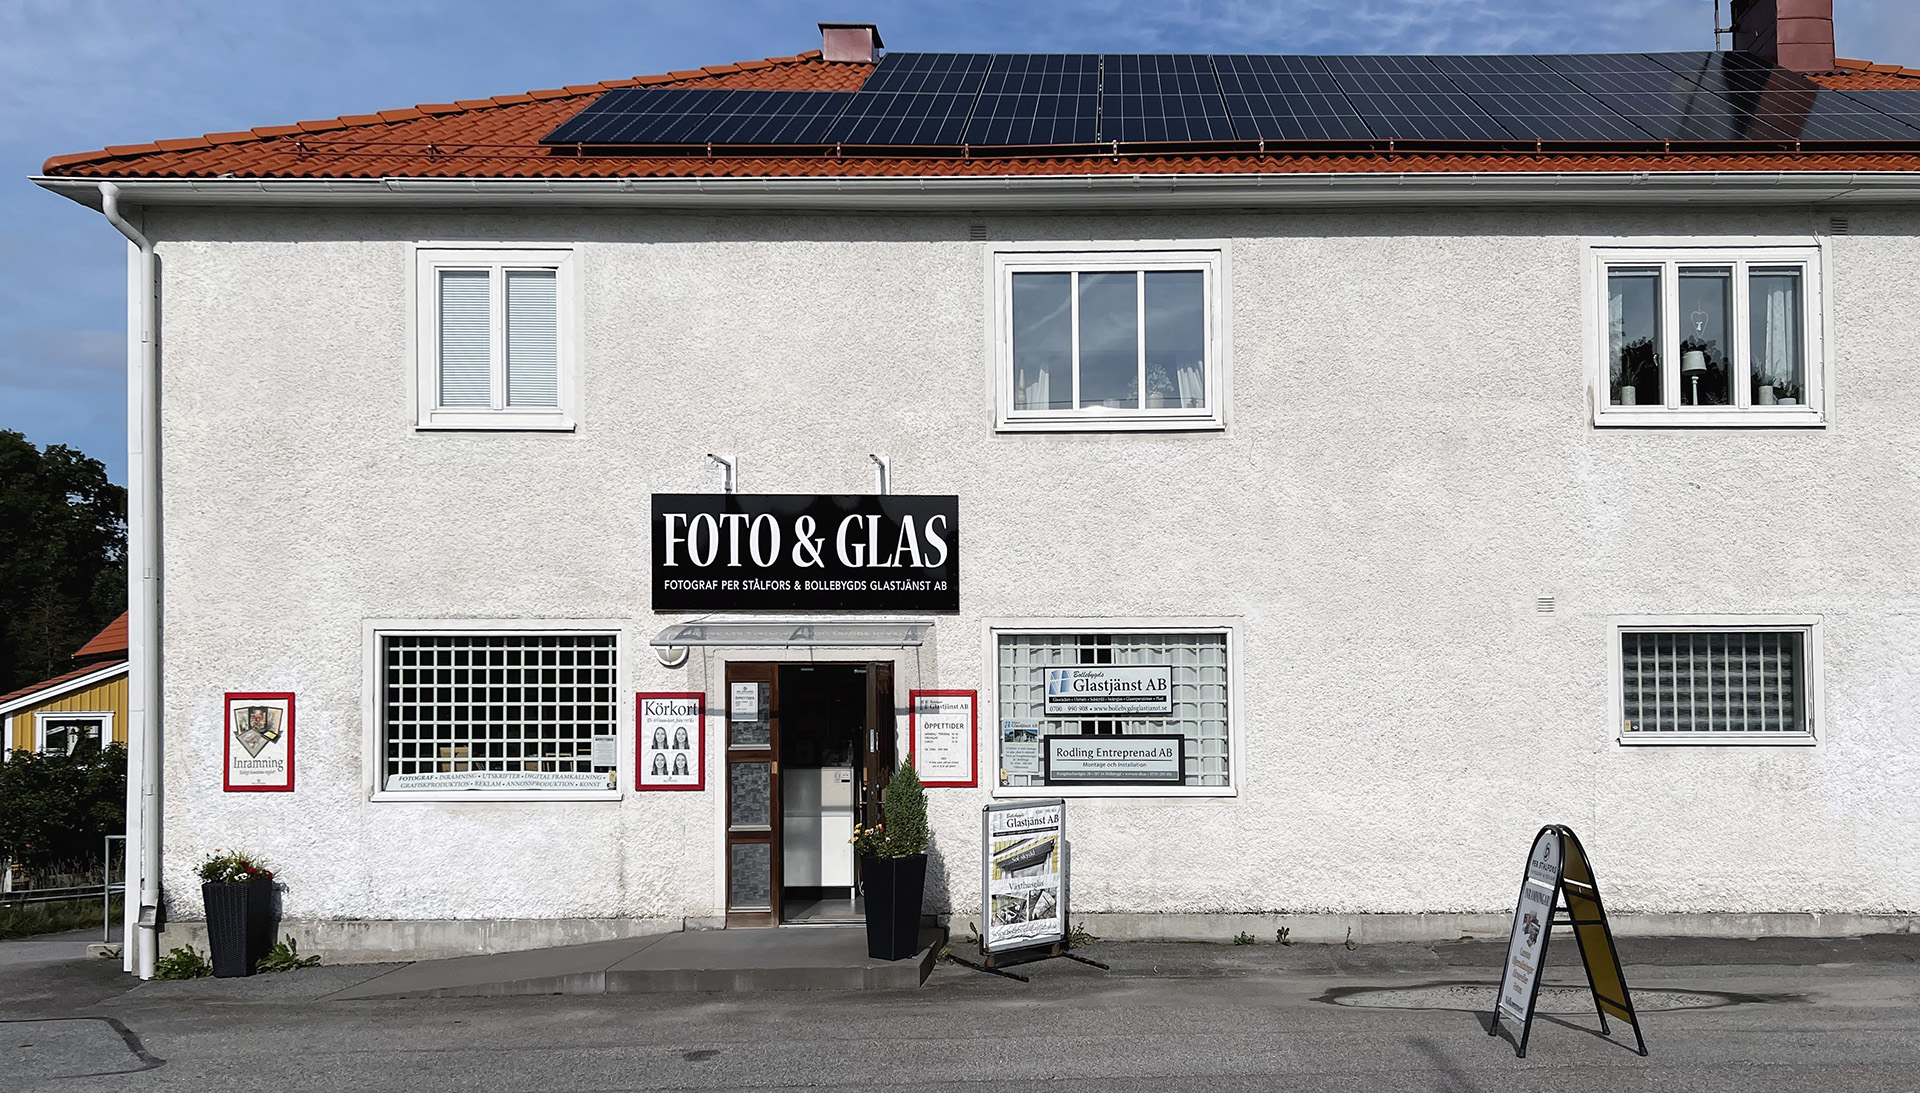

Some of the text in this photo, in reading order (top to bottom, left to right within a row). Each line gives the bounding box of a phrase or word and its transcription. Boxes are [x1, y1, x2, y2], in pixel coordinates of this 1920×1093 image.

[662, 513, 948, 568] FOTO & GLAS
[664, 578, 947, 591] FOTOGRAF PER STÅLFORS & BOLLEBYGDS GLASTJÄNST AB
[1073, 678, 1167, 695] Glastjänst AB
[645, 701, 697, 715] Körkort
[929, 703, 958, 711] Glastjänst
[924, 722, 964, 730] ÖPPETTIDER
[1056, 748, 1173, 759] Rodling Entreprenad AB
[233, 756, 284, 772] Inramning
[1006, 814, 1060, 828] Glastjänst AB
